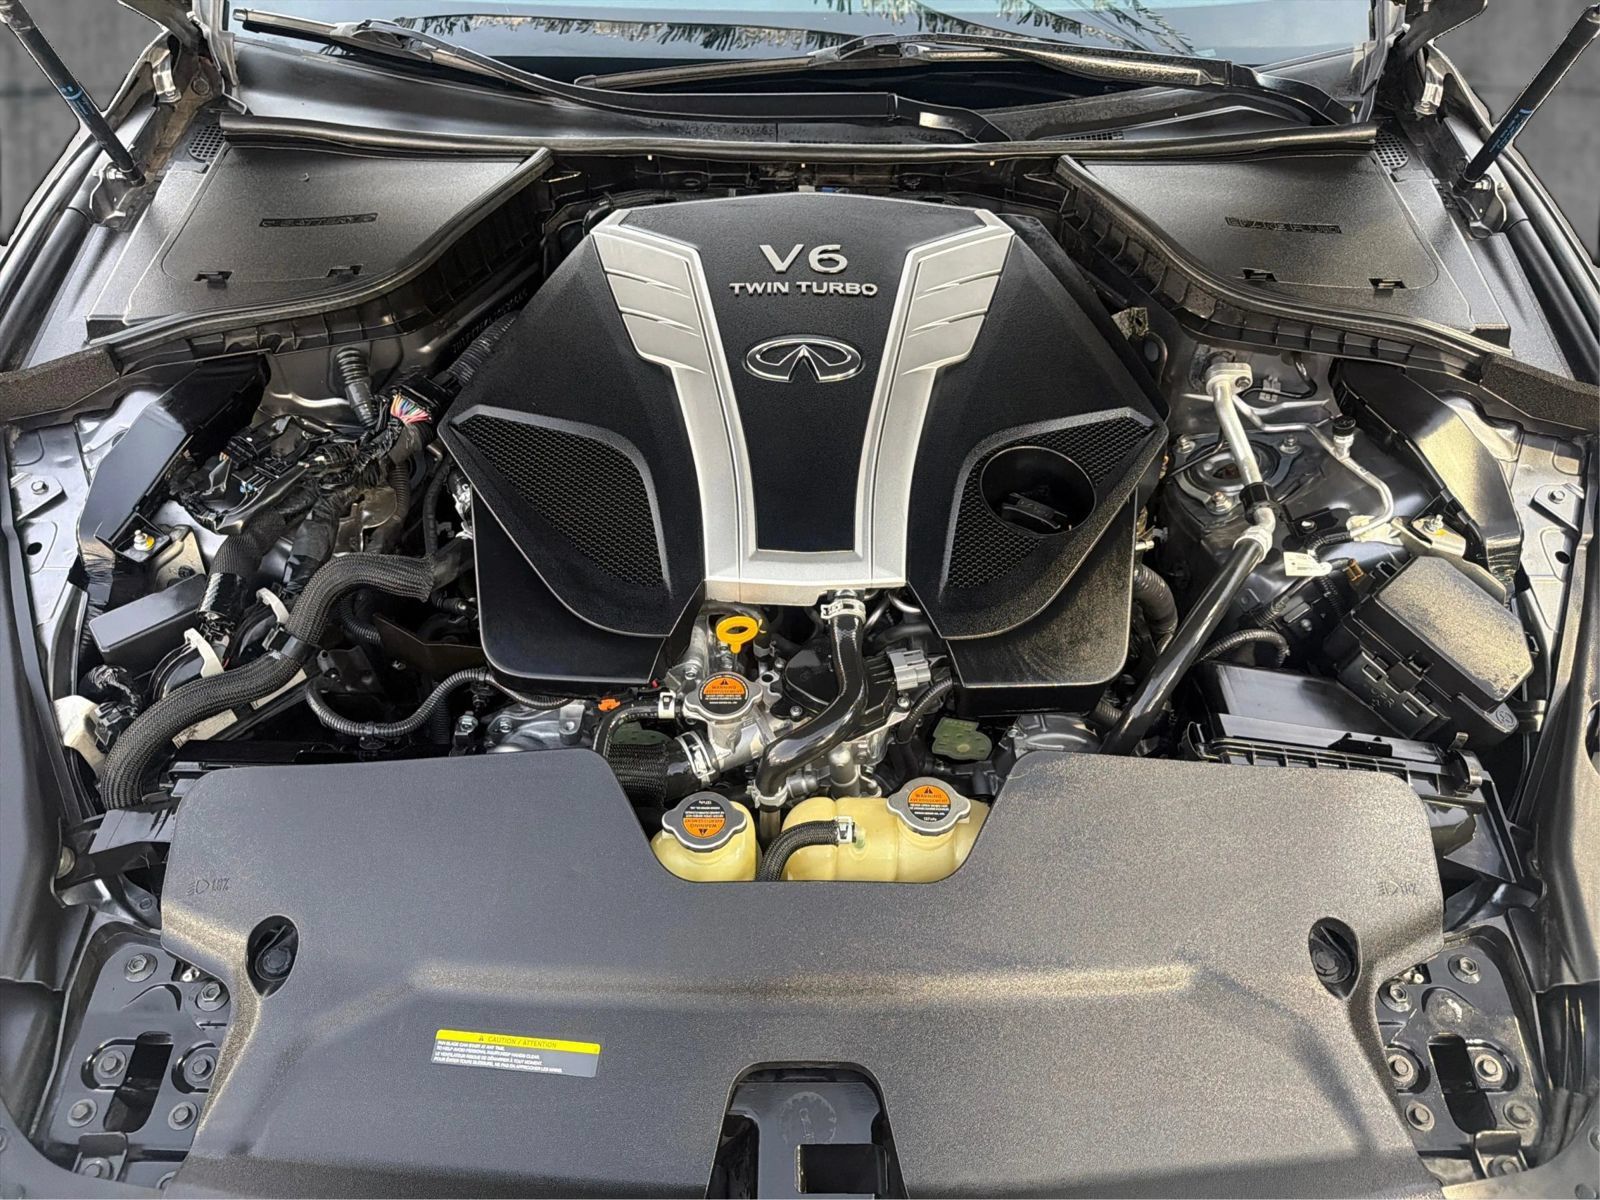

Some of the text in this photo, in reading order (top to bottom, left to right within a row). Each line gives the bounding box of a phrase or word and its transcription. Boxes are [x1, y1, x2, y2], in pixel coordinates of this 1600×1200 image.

[759, 244, 849, 274] V6
[729, 281, 879, 297] TWIN TURBO
[488, 1036, 516, 1045] CAUTION
[523, 1039, 557, 1049] ATTENTION
